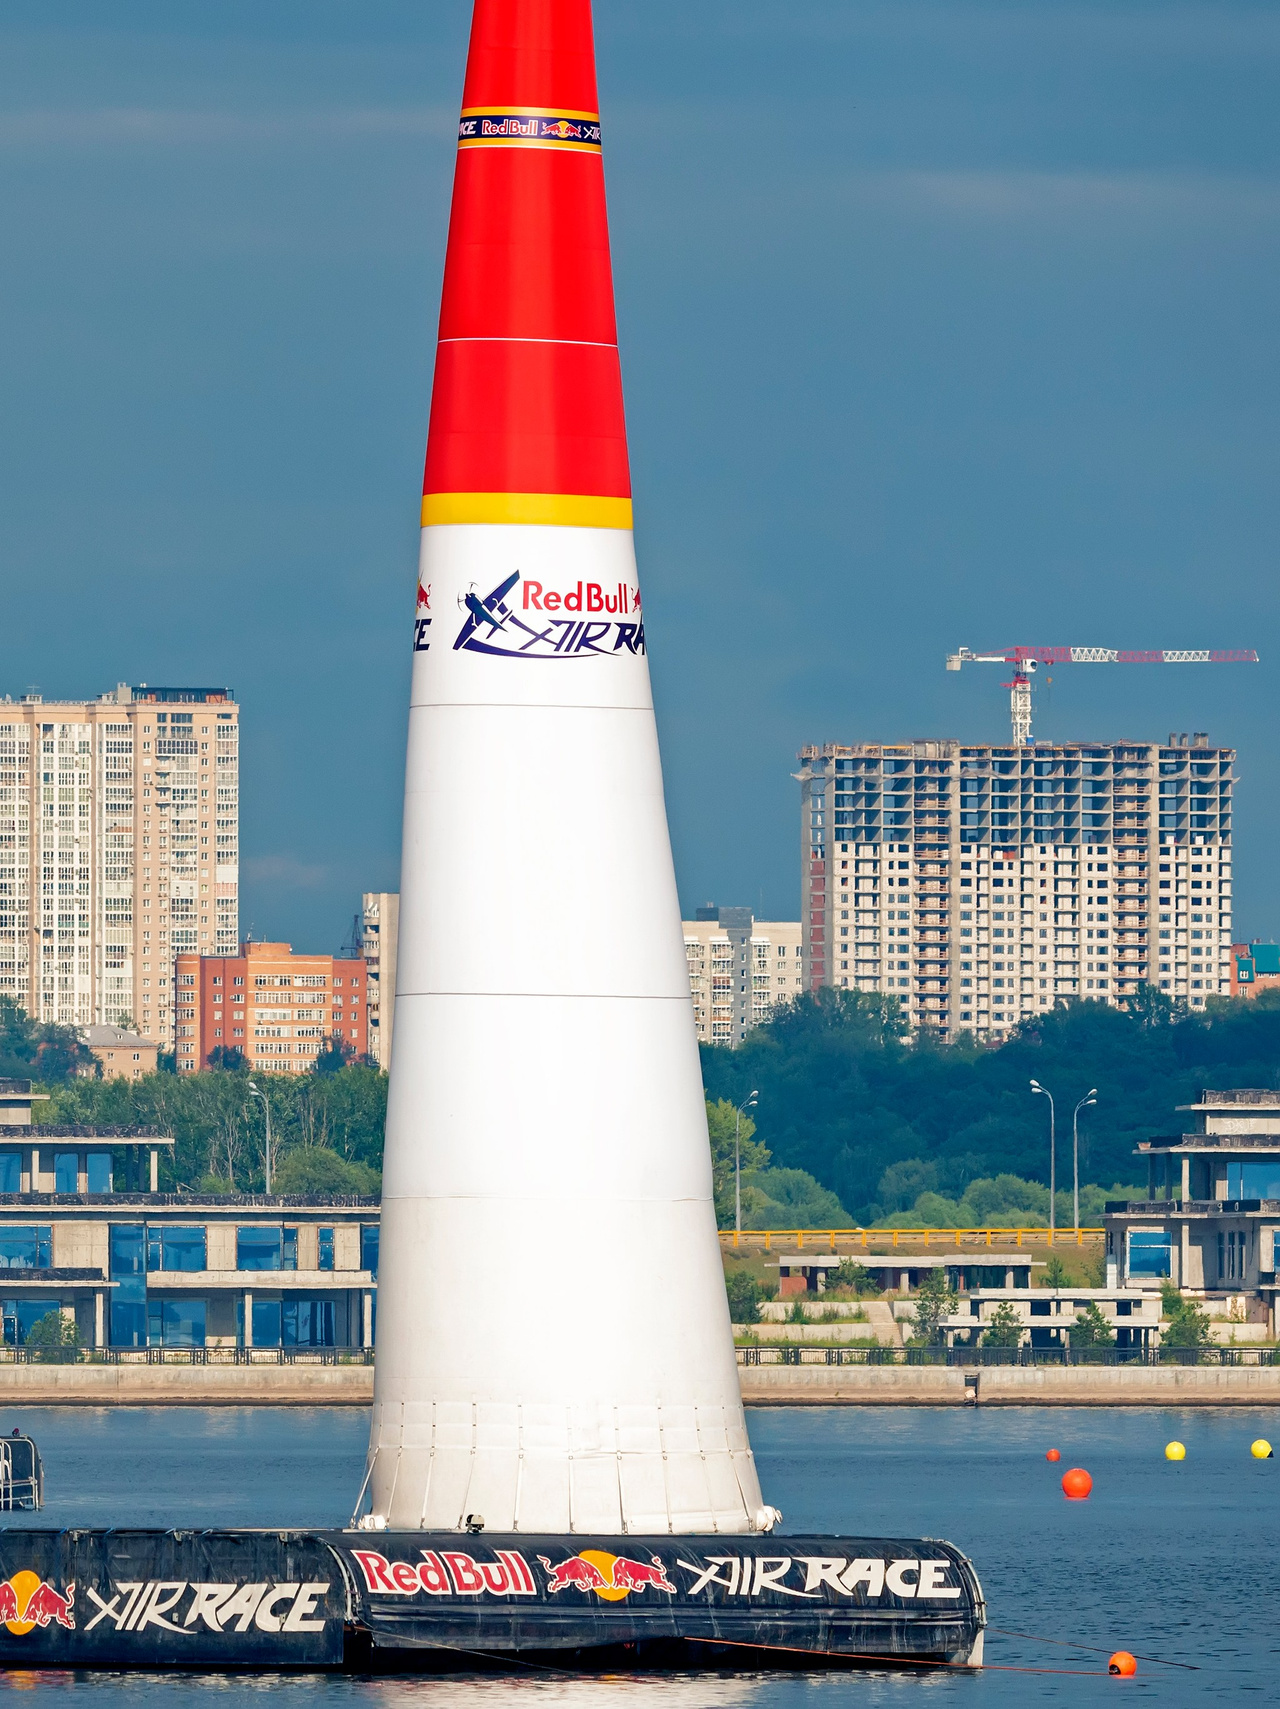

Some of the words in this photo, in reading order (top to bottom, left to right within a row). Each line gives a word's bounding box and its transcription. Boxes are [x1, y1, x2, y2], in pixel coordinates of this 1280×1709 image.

[677, 1556, 823, 1598] AIR
[803, 1556, 961, 1599] RACE
[84, 1582, 197, 1635] AIR
[184, 1583, 329, 1632] RACE
